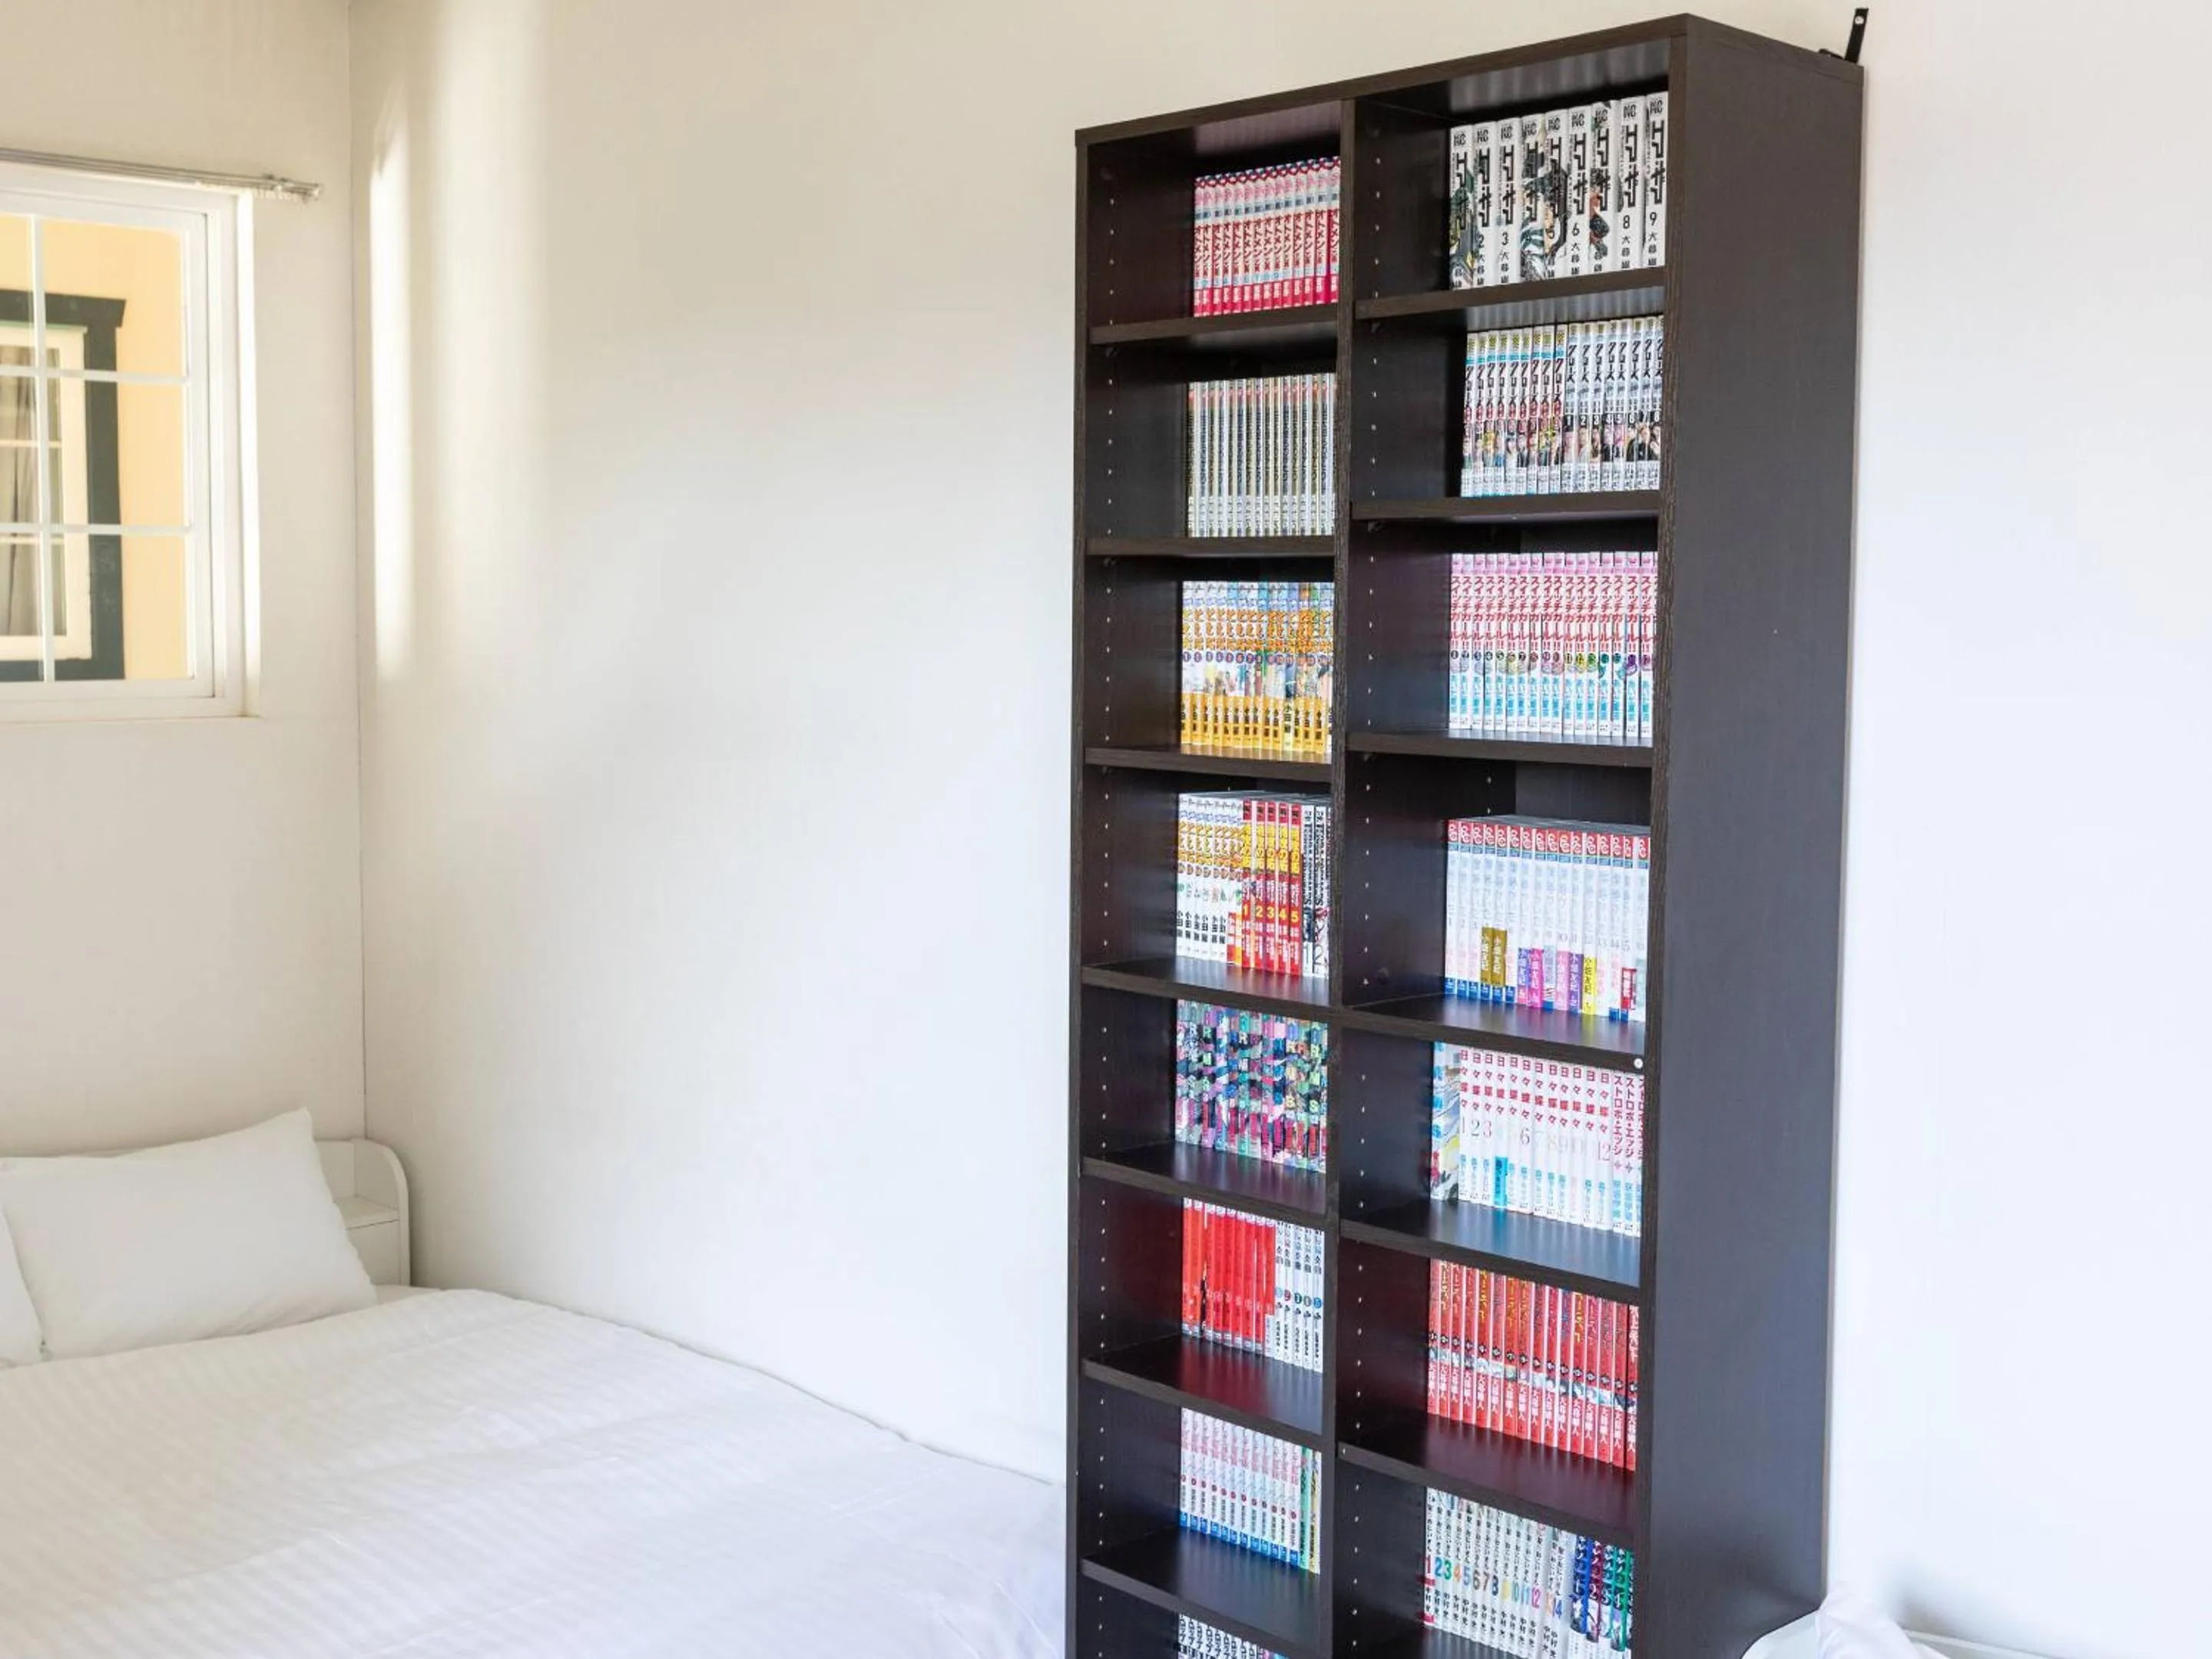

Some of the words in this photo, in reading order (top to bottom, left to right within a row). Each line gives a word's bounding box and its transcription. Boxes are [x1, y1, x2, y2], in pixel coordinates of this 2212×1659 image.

[1623, 215, 1630, 228] 8
[1650, 213, 1657, 226] 9
[1572, 222, 1580, 237] 6
[1478, 235, 1484, 248] 2
[1502, 232, 1508, 244] 3
[1567, 415, 1571, 425] 1
[1581, 415, 1586, 425] 2
[1594, 415, 1599, 425] 3
[1243, 906, 1248, 916] 1
[1257, 906, 1263, 918] 2
[1267, 906, 1274, 919] 3
[1280, 908, 1287, 921] 4
[1291, 911, 1299, 922] 5
[1472, 1119, 1480, 1137] 2
[1483, 1121, 1492, 1137] 3
[1521, 1128, 1530, 1145] 6
[1598, 1140, 1611, 1161] 12
[1426, 1555, 1431, 1574] 1
[1435, 1557, 1443, 1576] 2
[1444, 1560, 1452, 1579] 3
[1463, 1566, 1470, 1585] 5
[1474, 1570, 1480, 1590] 6
[1483, 1571, 1489, 1591] 7
[1492, 1575, 1498, 1595] 8
[1589, 1583, 1596, 1599] 2
[1532, 1586, 1540, 1608] 12
[1552, 1598, 1562, 1619] 14
